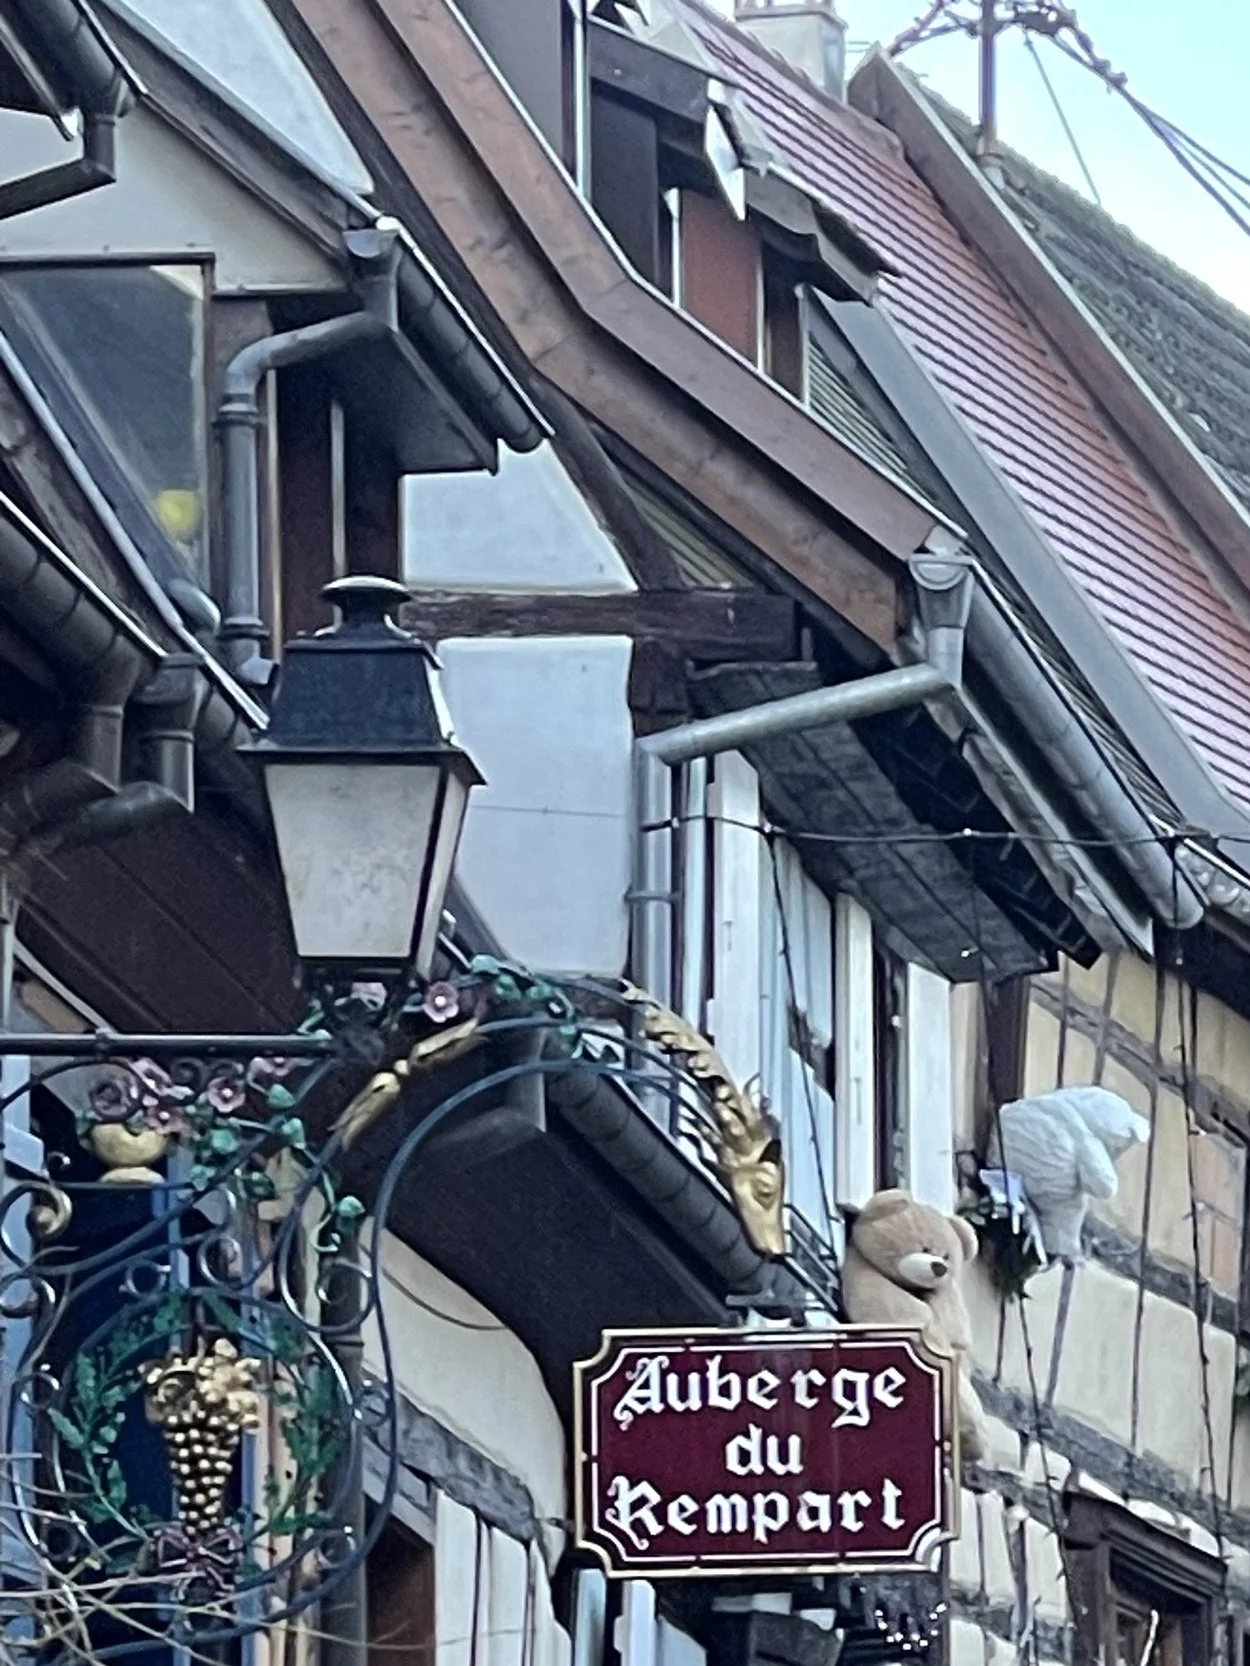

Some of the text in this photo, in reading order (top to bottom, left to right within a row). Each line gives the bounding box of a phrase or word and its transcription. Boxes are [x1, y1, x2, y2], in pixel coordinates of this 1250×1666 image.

[613, 1354, 906, 1431] Auberge
[724, 1423, 804, 1476] du
[605, 1475, 906, 1551] Rempart
